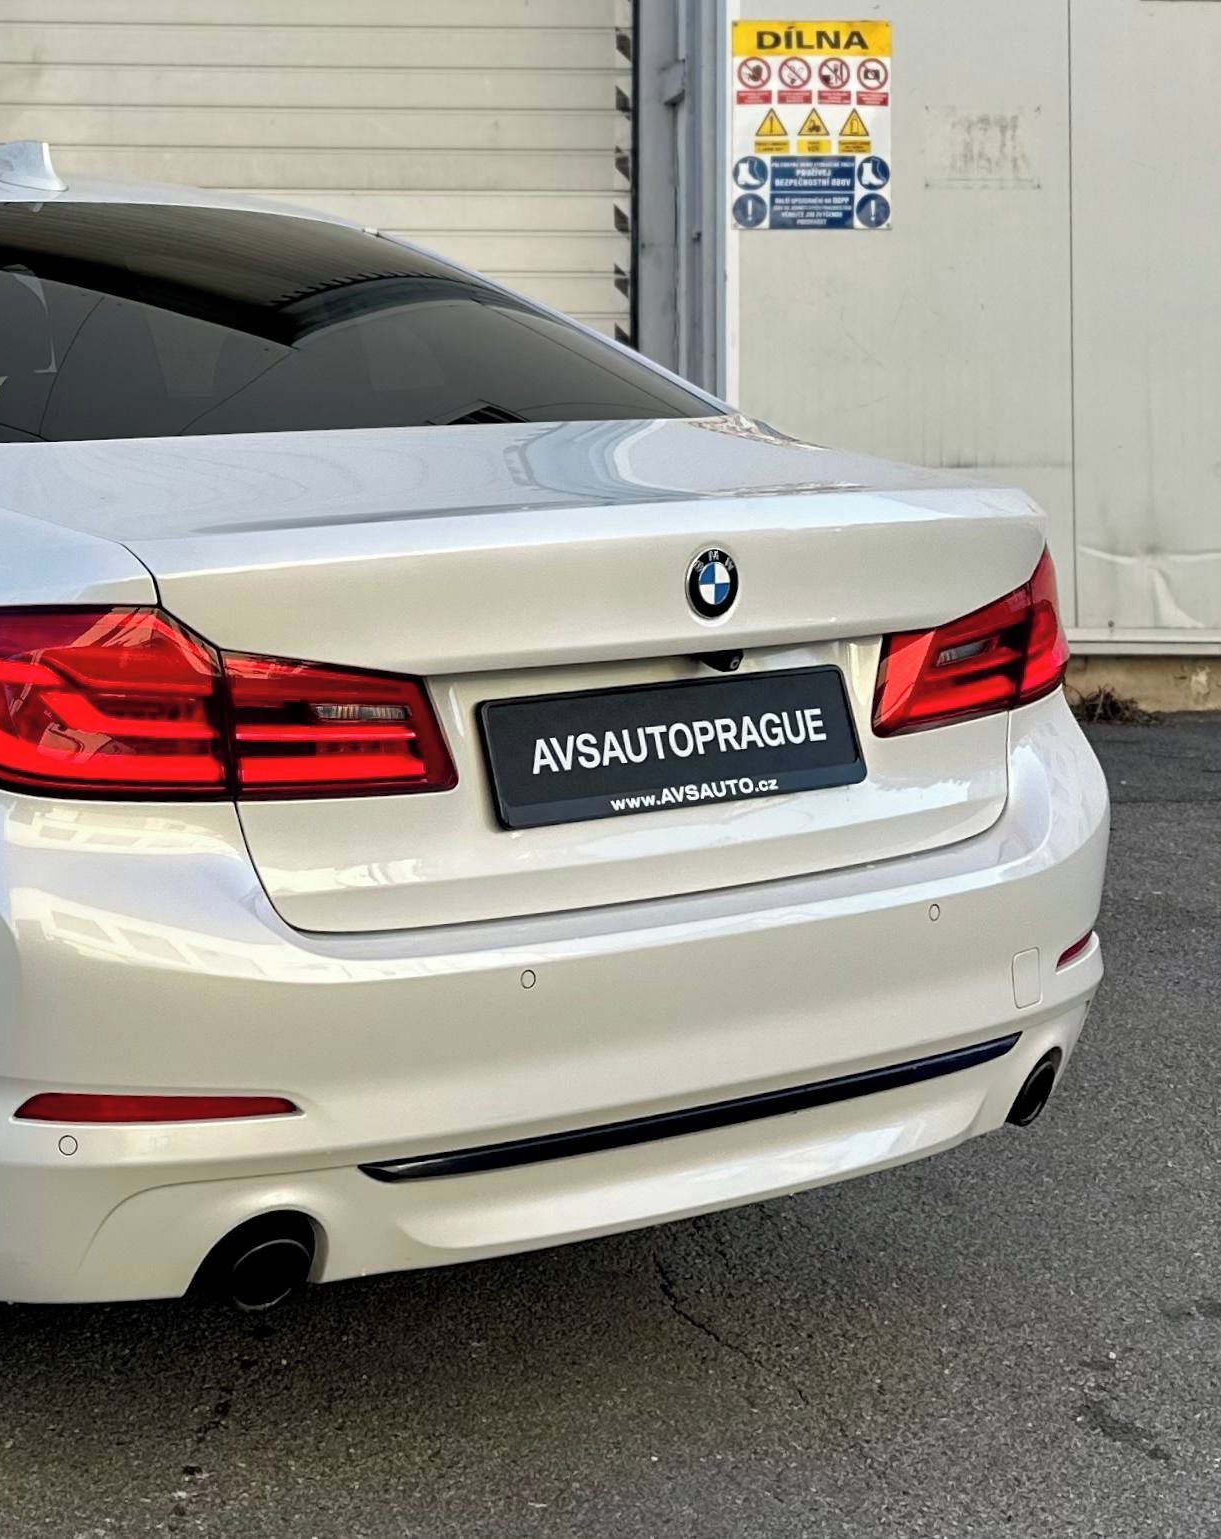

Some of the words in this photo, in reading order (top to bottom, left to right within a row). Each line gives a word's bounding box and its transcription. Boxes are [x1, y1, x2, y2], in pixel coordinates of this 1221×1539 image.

[756, 26, 869, 50] DÍLNA
[694, 550, 734, 573] BMW
[532, 708, 827, 775] AVSAUTOPRAGUE
[610, 777, 779, 811] www.AVSAUTO.cz
